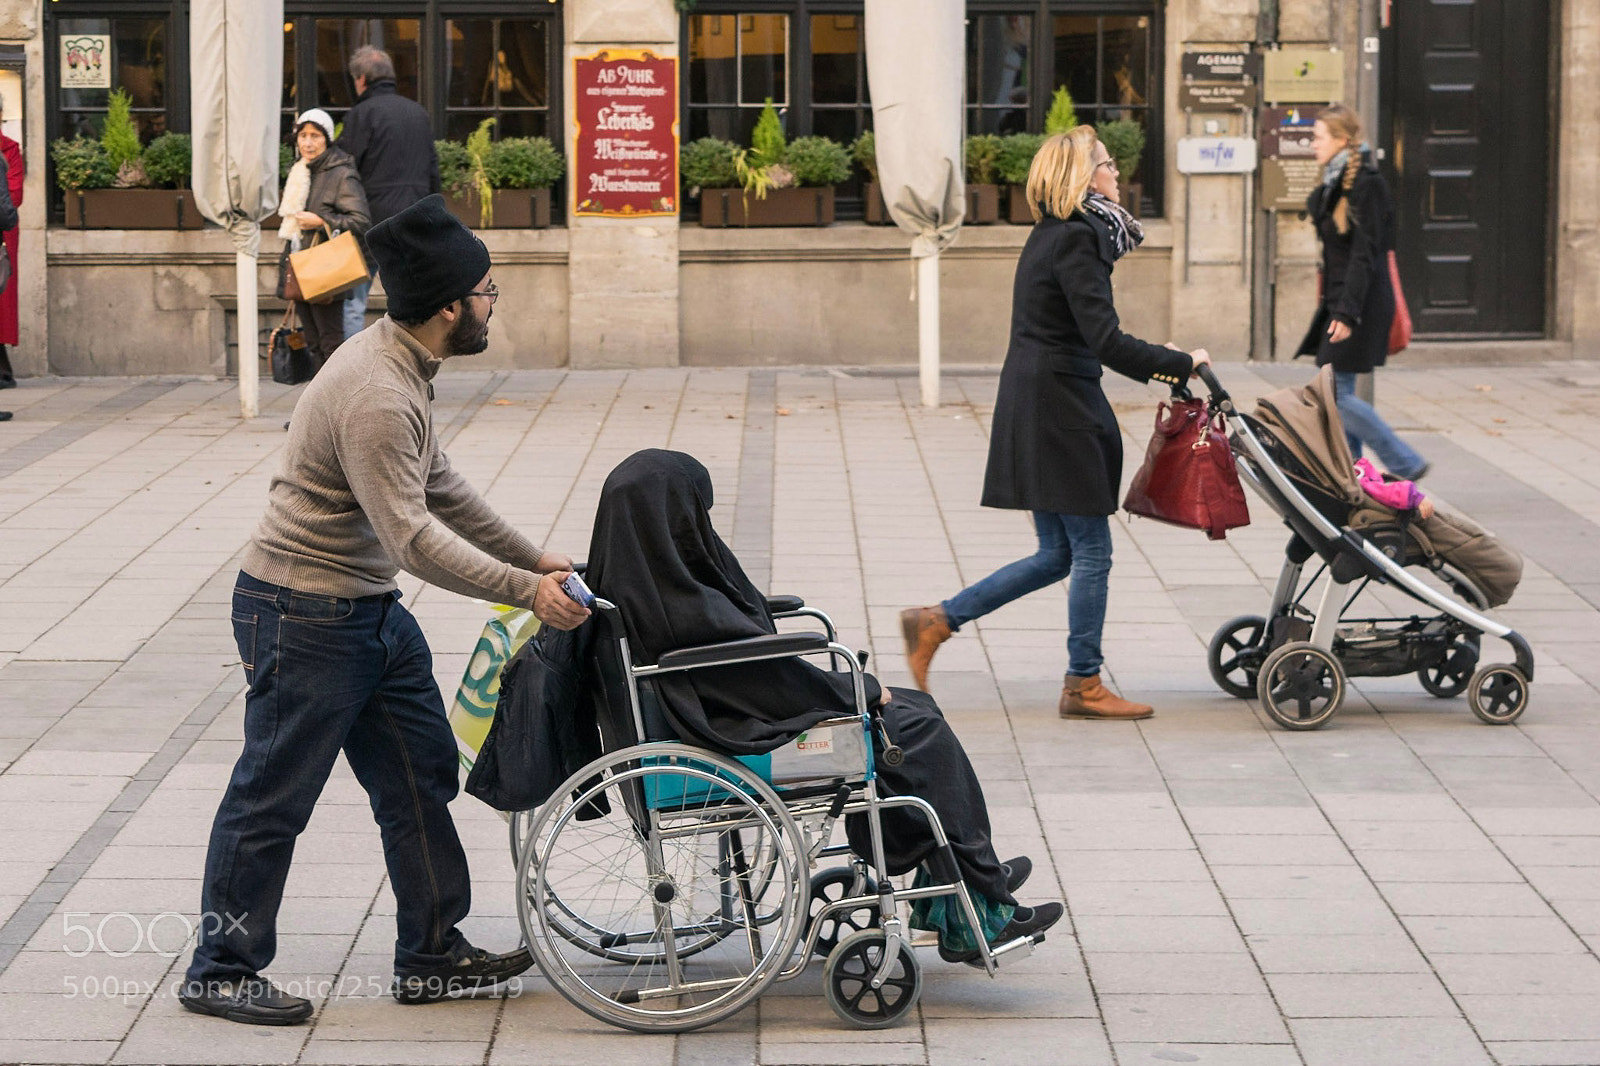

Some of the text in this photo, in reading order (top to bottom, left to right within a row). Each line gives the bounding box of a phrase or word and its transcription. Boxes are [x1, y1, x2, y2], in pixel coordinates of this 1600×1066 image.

[1197, 54, 1245, 66] AGEMAS
[597, 68, 617, 84] AB
[627, 68, 655, 84] UHR
